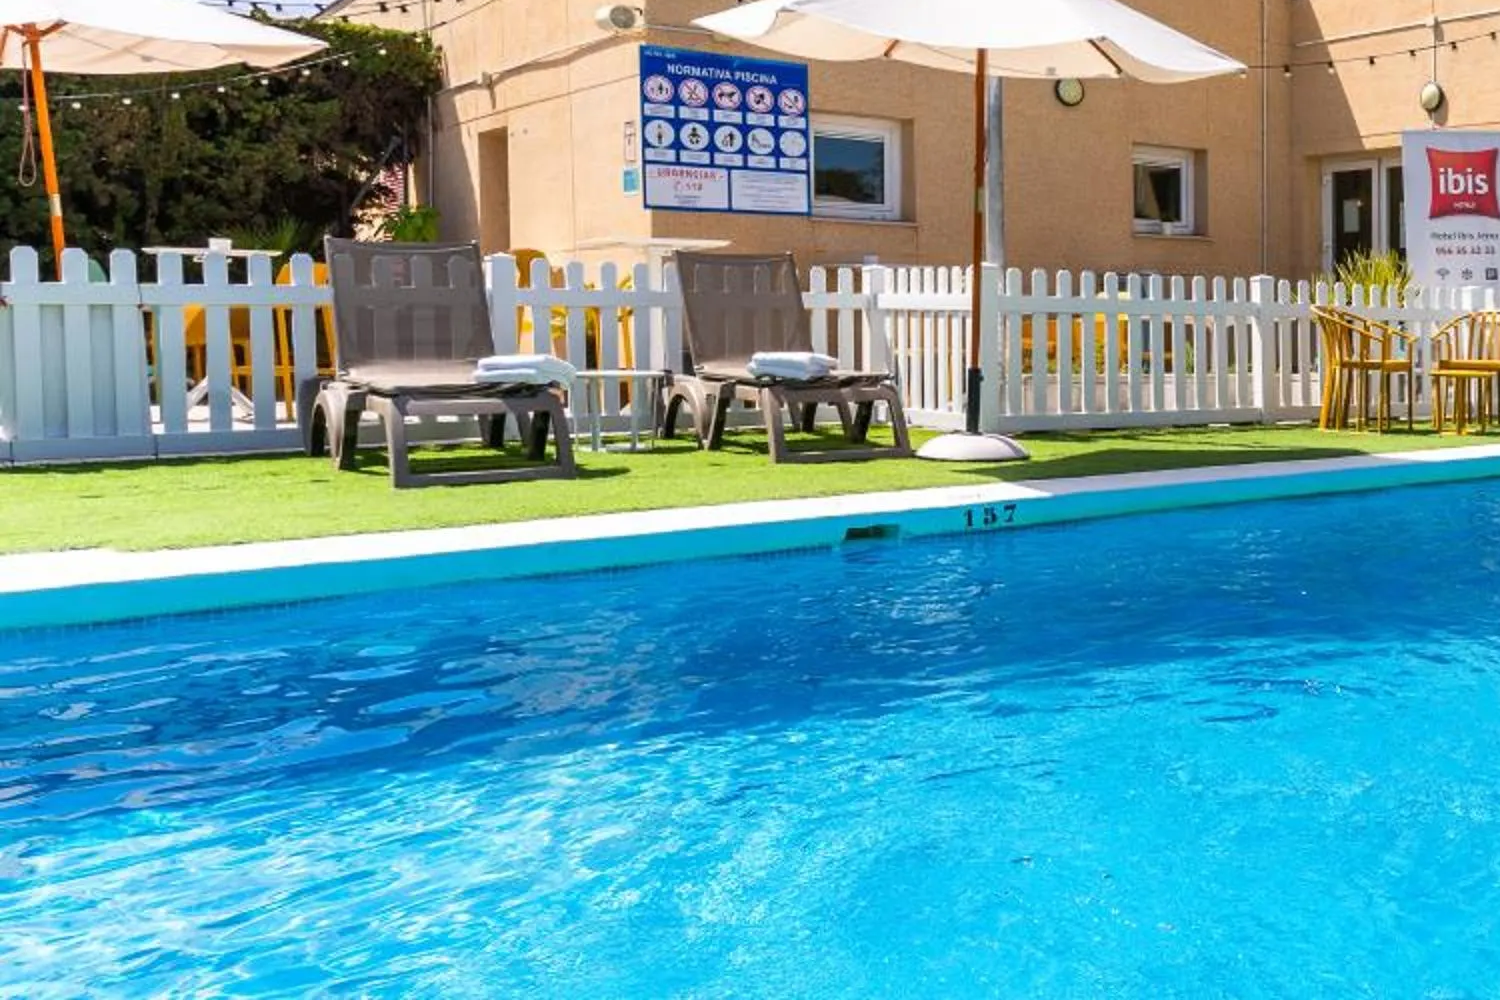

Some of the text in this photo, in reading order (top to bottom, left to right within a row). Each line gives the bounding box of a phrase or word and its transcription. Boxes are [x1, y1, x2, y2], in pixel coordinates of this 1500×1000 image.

[666, 63, 778, 85] NORMATIVA PISCINA
[1438, 167, 1489, 195] ibis
[964, 504, 1017, 526] 157
